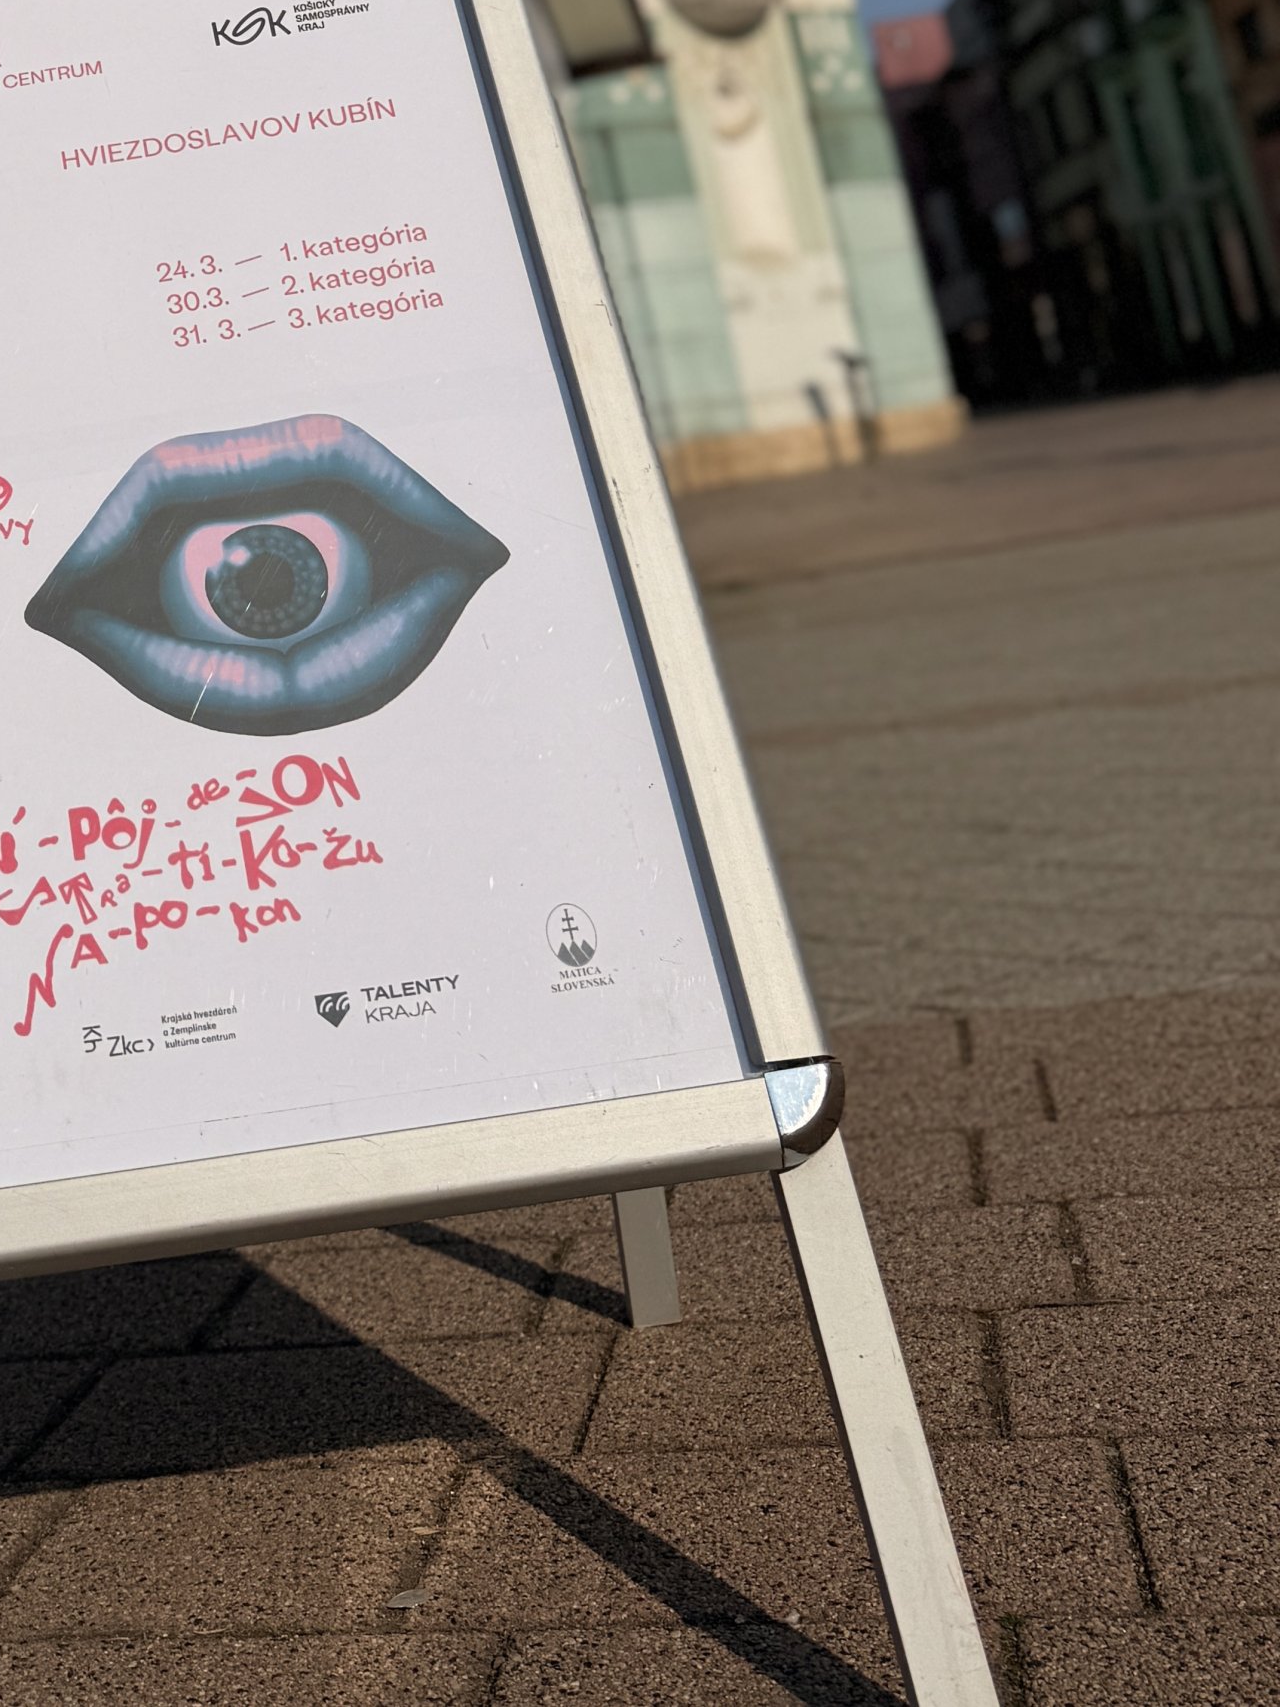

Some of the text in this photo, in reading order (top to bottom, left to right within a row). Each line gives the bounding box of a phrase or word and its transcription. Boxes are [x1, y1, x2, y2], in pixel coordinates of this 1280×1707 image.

[295, 3, 370, 23] SAMOSPRÁVNY
[297, 21, 325, 33] KRAJ
[2, 60, 103, 89] CENTRUM
[61, 97, 397, 170] HVIEZDOSLAVOV KUBÍN
[279, 243, 299, 262] 1.
[302, 223, 428, 260] kategória
[167, 287, 230, 315] 30.3.
[281, 275, 305, 296] 2.
[309, 255, 436, 292] kategória
[287, 308, 312, 329] 3.
[315, 289, 444, 325] kategória
[550, 973, 616, 994] SLOVENSKÁ
[559, 965, 602, 982] MATICA
[360, 974, 460, 1003] TALENTY
[161, 1005, 238, 1024] Krajská hvezdáreň
[365, 1000, 437, 1024] KRAJA
[163, 1022, 217, 1037] a Zemplínske
[165, 1031, 236, 1049] kultúrne centrum
